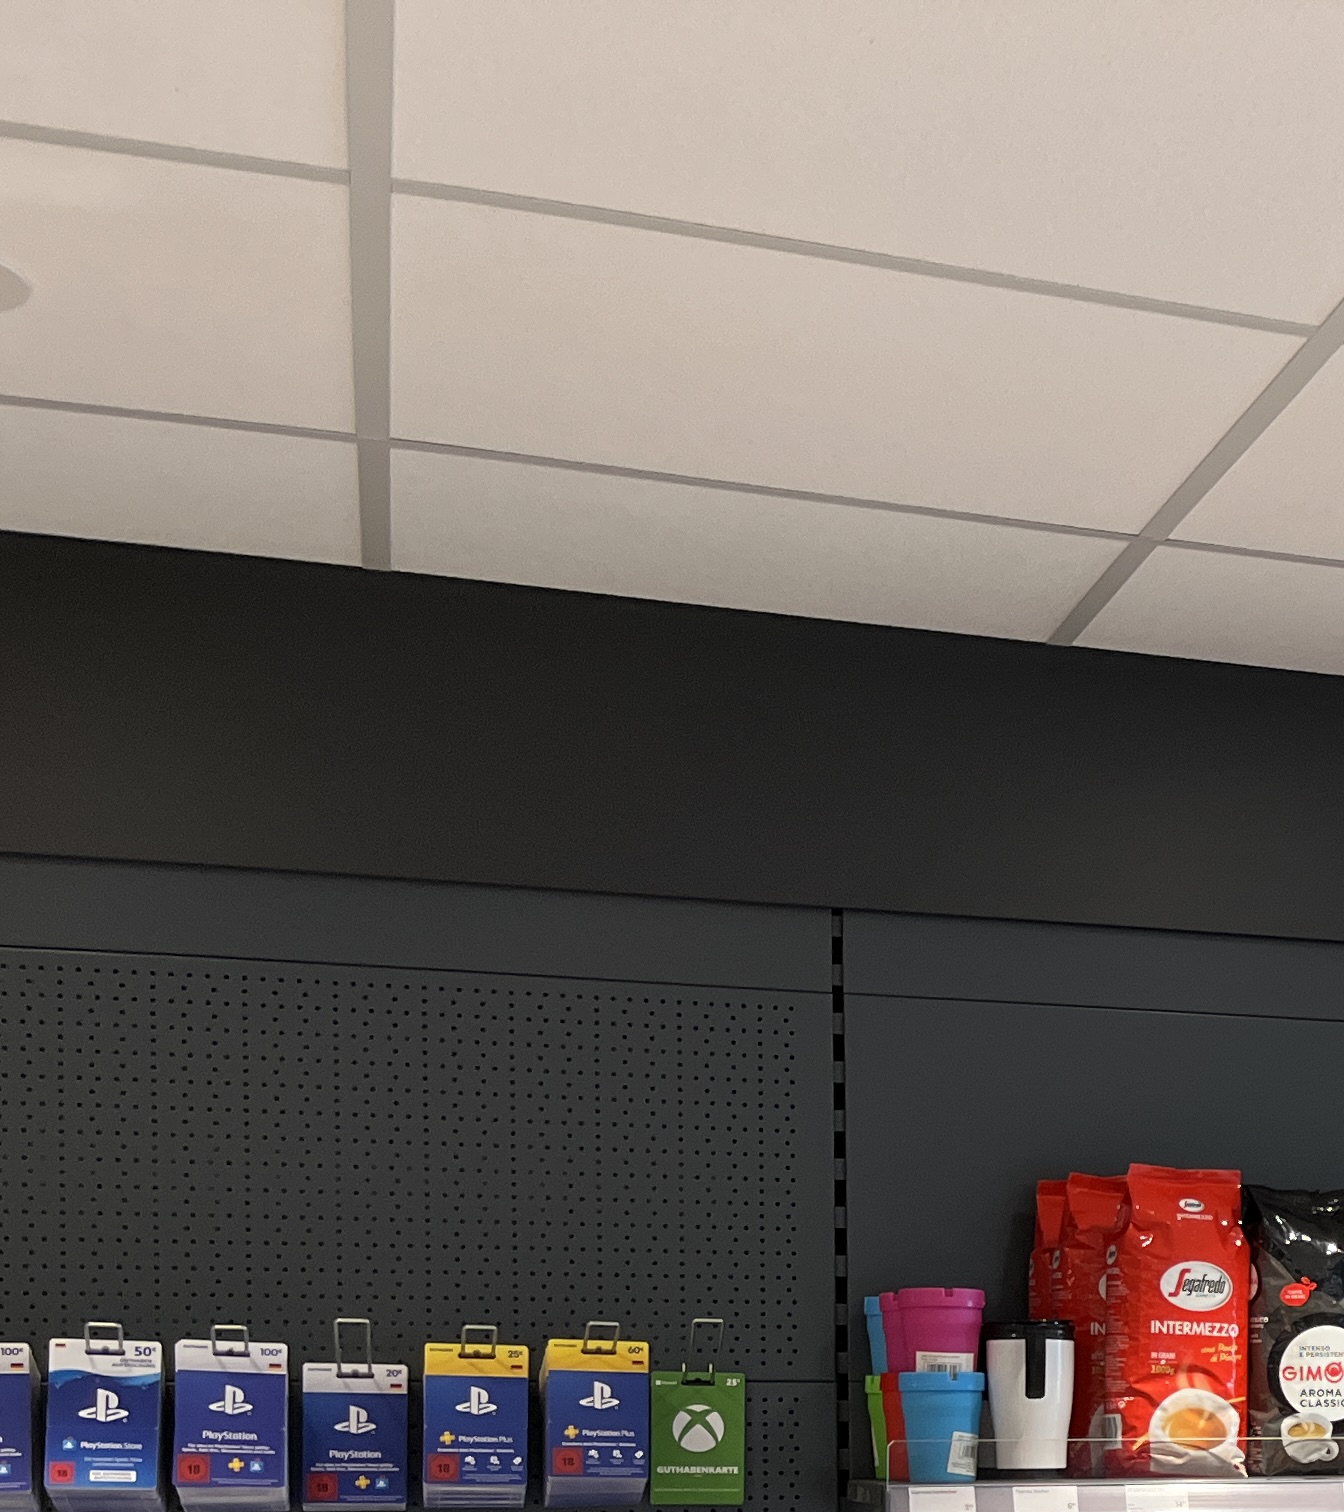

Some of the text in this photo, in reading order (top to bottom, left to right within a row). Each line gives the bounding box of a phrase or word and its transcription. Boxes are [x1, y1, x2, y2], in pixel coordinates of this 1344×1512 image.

[1169, 1269, 1226, 1297] Segafredo
[1151, 1320, 1239, 1337] INTERMEZZO
[1300, 1388, 1342, 1398] AROMA
[202, 1431, 257, 1441] PlayStation
[329, 1450, 381, 1459] PlayStation
[657, 1466, 738, 1474] GUTHABENKARTE
